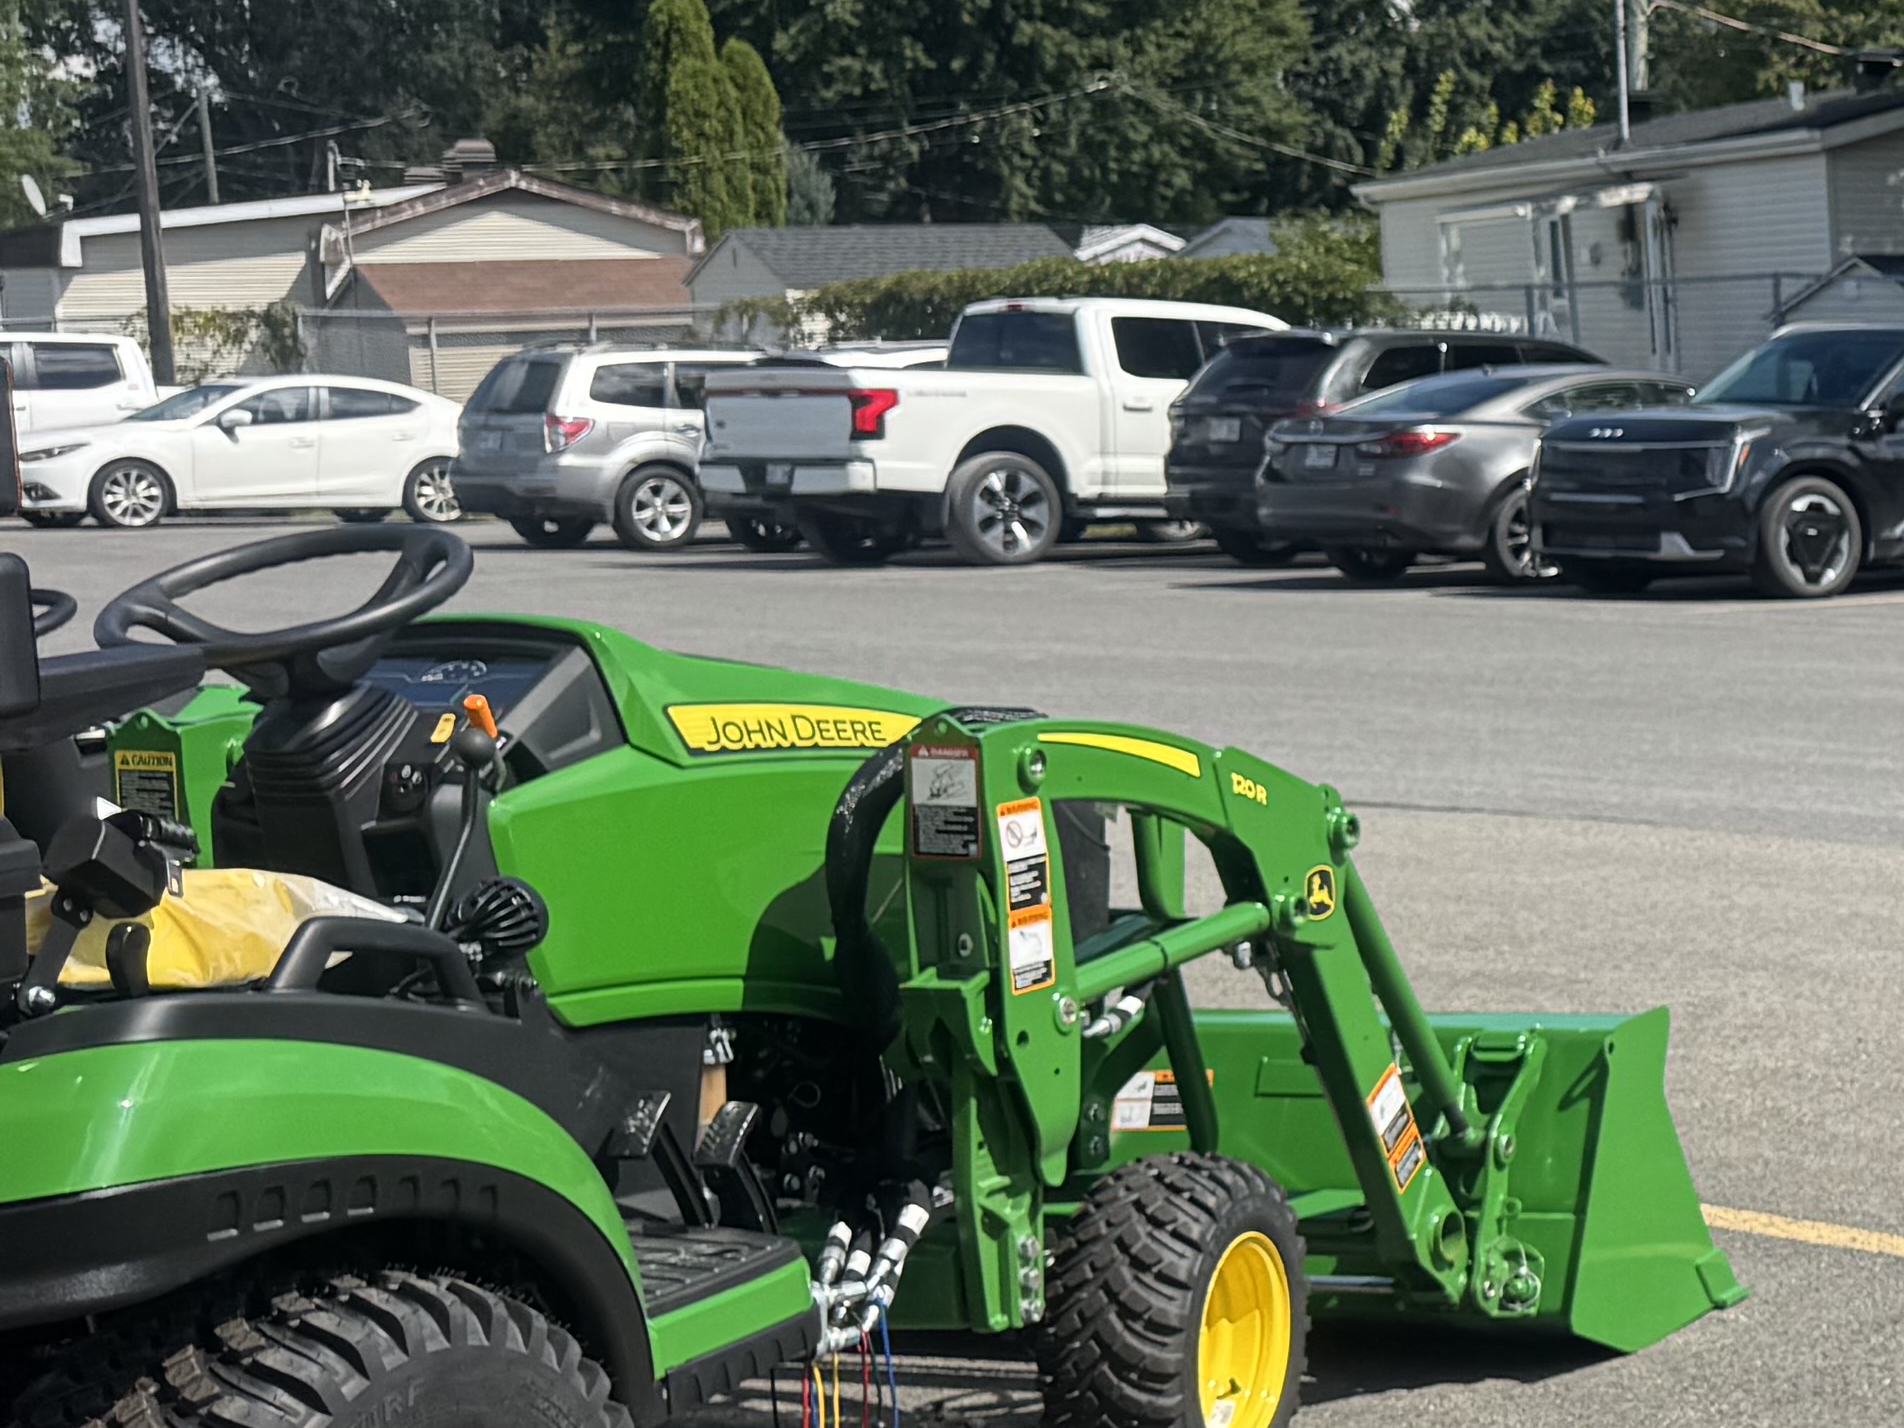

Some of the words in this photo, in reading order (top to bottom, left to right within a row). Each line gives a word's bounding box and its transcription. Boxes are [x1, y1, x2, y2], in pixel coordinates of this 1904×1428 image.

[707, 715, 788, 746] JOHN
[791, 714, 888, 743] DEERE
[131, 754, 173, 767] CAUTION
